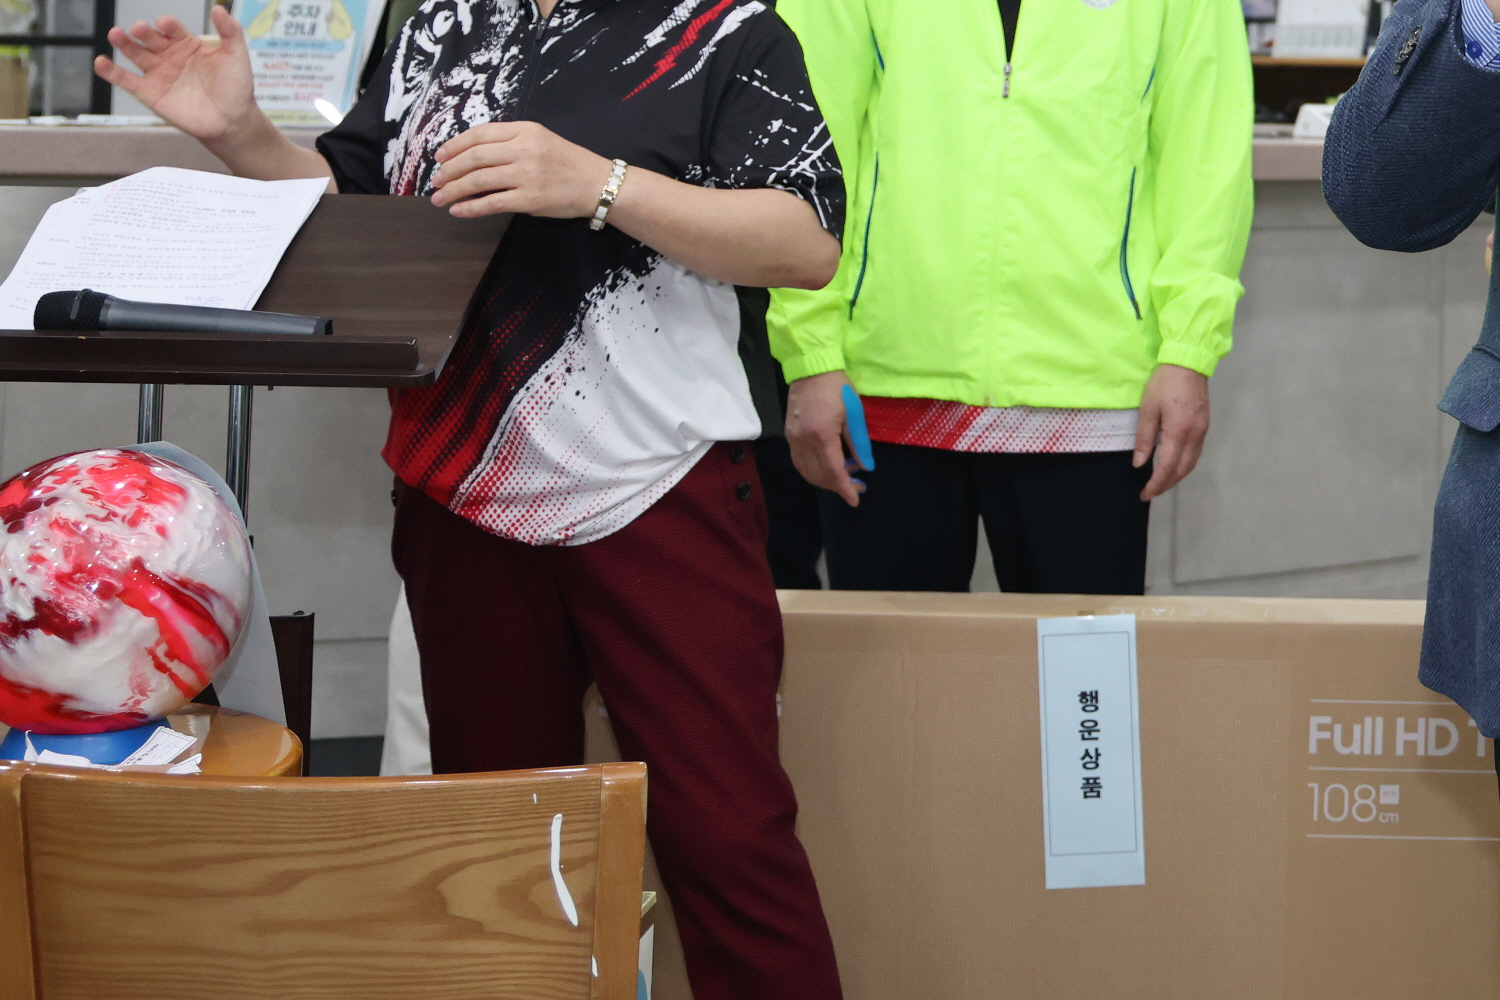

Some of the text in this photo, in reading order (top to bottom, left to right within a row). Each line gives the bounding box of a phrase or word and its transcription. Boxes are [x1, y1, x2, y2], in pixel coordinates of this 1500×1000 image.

[283, 21, 317, 36] 안내
[287, 3, 321, 18] 주차
[1077, 690, 1102, 799] 행운상품
[1309, 716, 1383, 755] Full
[1395, 717, 1459, 757] HD
[1307, 783, 1399, 823] 108 cm
